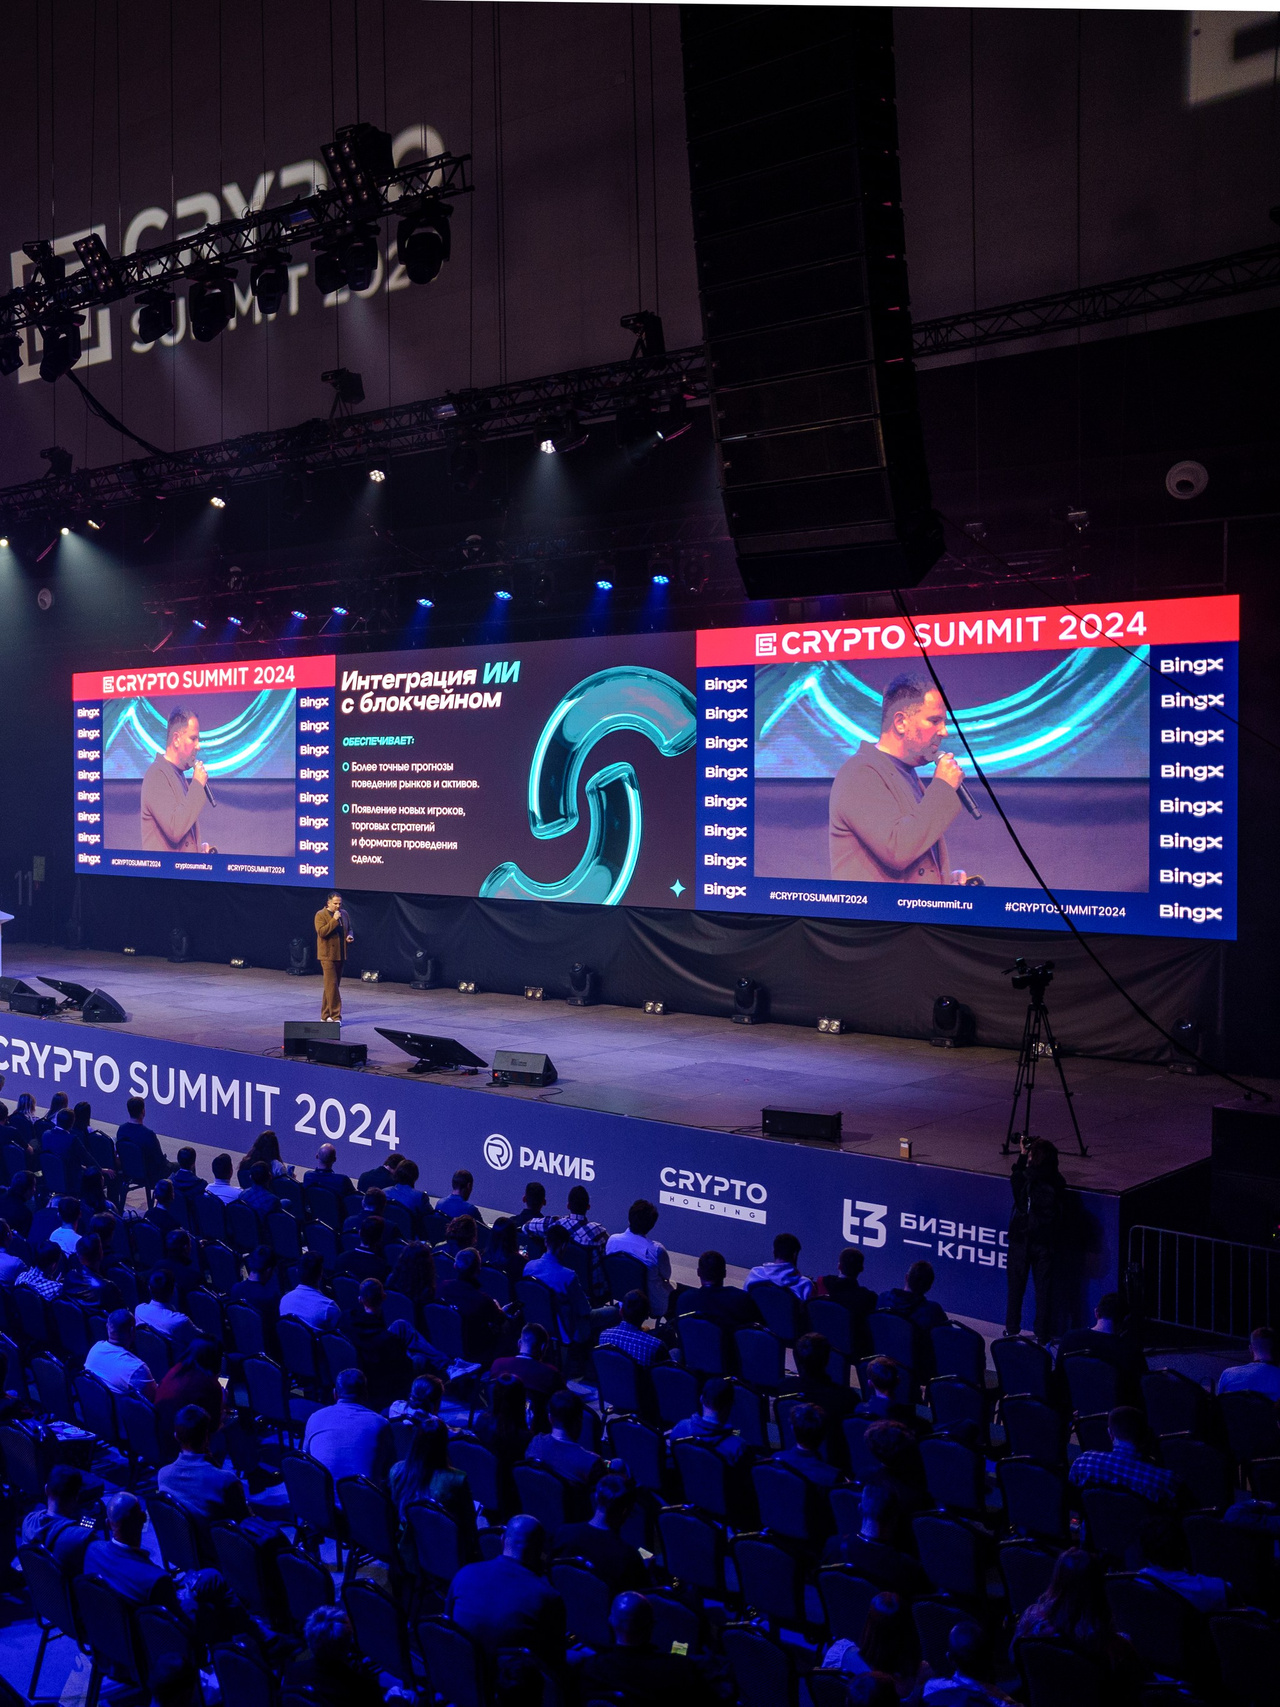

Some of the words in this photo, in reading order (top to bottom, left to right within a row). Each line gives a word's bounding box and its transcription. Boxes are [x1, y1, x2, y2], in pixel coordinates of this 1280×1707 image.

[782, 625, 905, 654] CRYPTO
[913, 616, 1046, 647] SUMMIT
[1059, 611, 1146, 640] 2024
[116, 672, 179, 692] CRYPTO
[183, 667, 248, 688] SUMMIT
[254, 665, 295, 684] 2024
[341, 670, 477, 692] Интеграция
[483, 661, 520, 684] ИИ
[342, 698, 354, 713] с
[359, 688, 502, 713] блокчейном
[343, 736, 414, 746] ОБЕСПЕЧИВАЕТ:
[352, 762, 377, 772] Более
[378, 764, 409, 772] точные
[411, 763, 453, 773] прогнозы
[352, 780, 398, 790] поведения
[399, 780, 431, 790] рынков
[434, 780, 440, 788] и
[441, 780, 479, 788] активов.
[352, 804, 397, 814] Появление
[398, 806, 425, 814] новых
[427, 806, 465, 816] игроков,
[352, 822, 389, 832] торговых
[391, 822, 435, 833] стратегий
[352, 838, 357, 846] и
[358, 837, 402, 848] форматов
[403, 840, 457, 850] проведения
[112, 858, 161, 868] #CRYPTOSUMMIT2024
[175, 862, 212, 870] cryptosummit.ru
[228, 864, 285, 874] #CRYPTOSUMMIT2024
[352, 854, 384, 864] сделок.
[770, 892, 867, 904] #CRYPTOSUMMIT2024
[898, 899, 972, 909] cryptosummit.ru
[1004, 901, 1127, 918] #CRYPTOSUMMIT2024
[129, 1061, 280, 1125] SUMMIT
[295, 1094, 399, 1150] 2024
[520, 1147, 595, 1181] РАКИБ
[660, 1167, 767, 1204] CRYPTO
[669, 1195, 756, 1219] HOLDING
[900, 1212, 1009, 1248] БИЗНЕС
